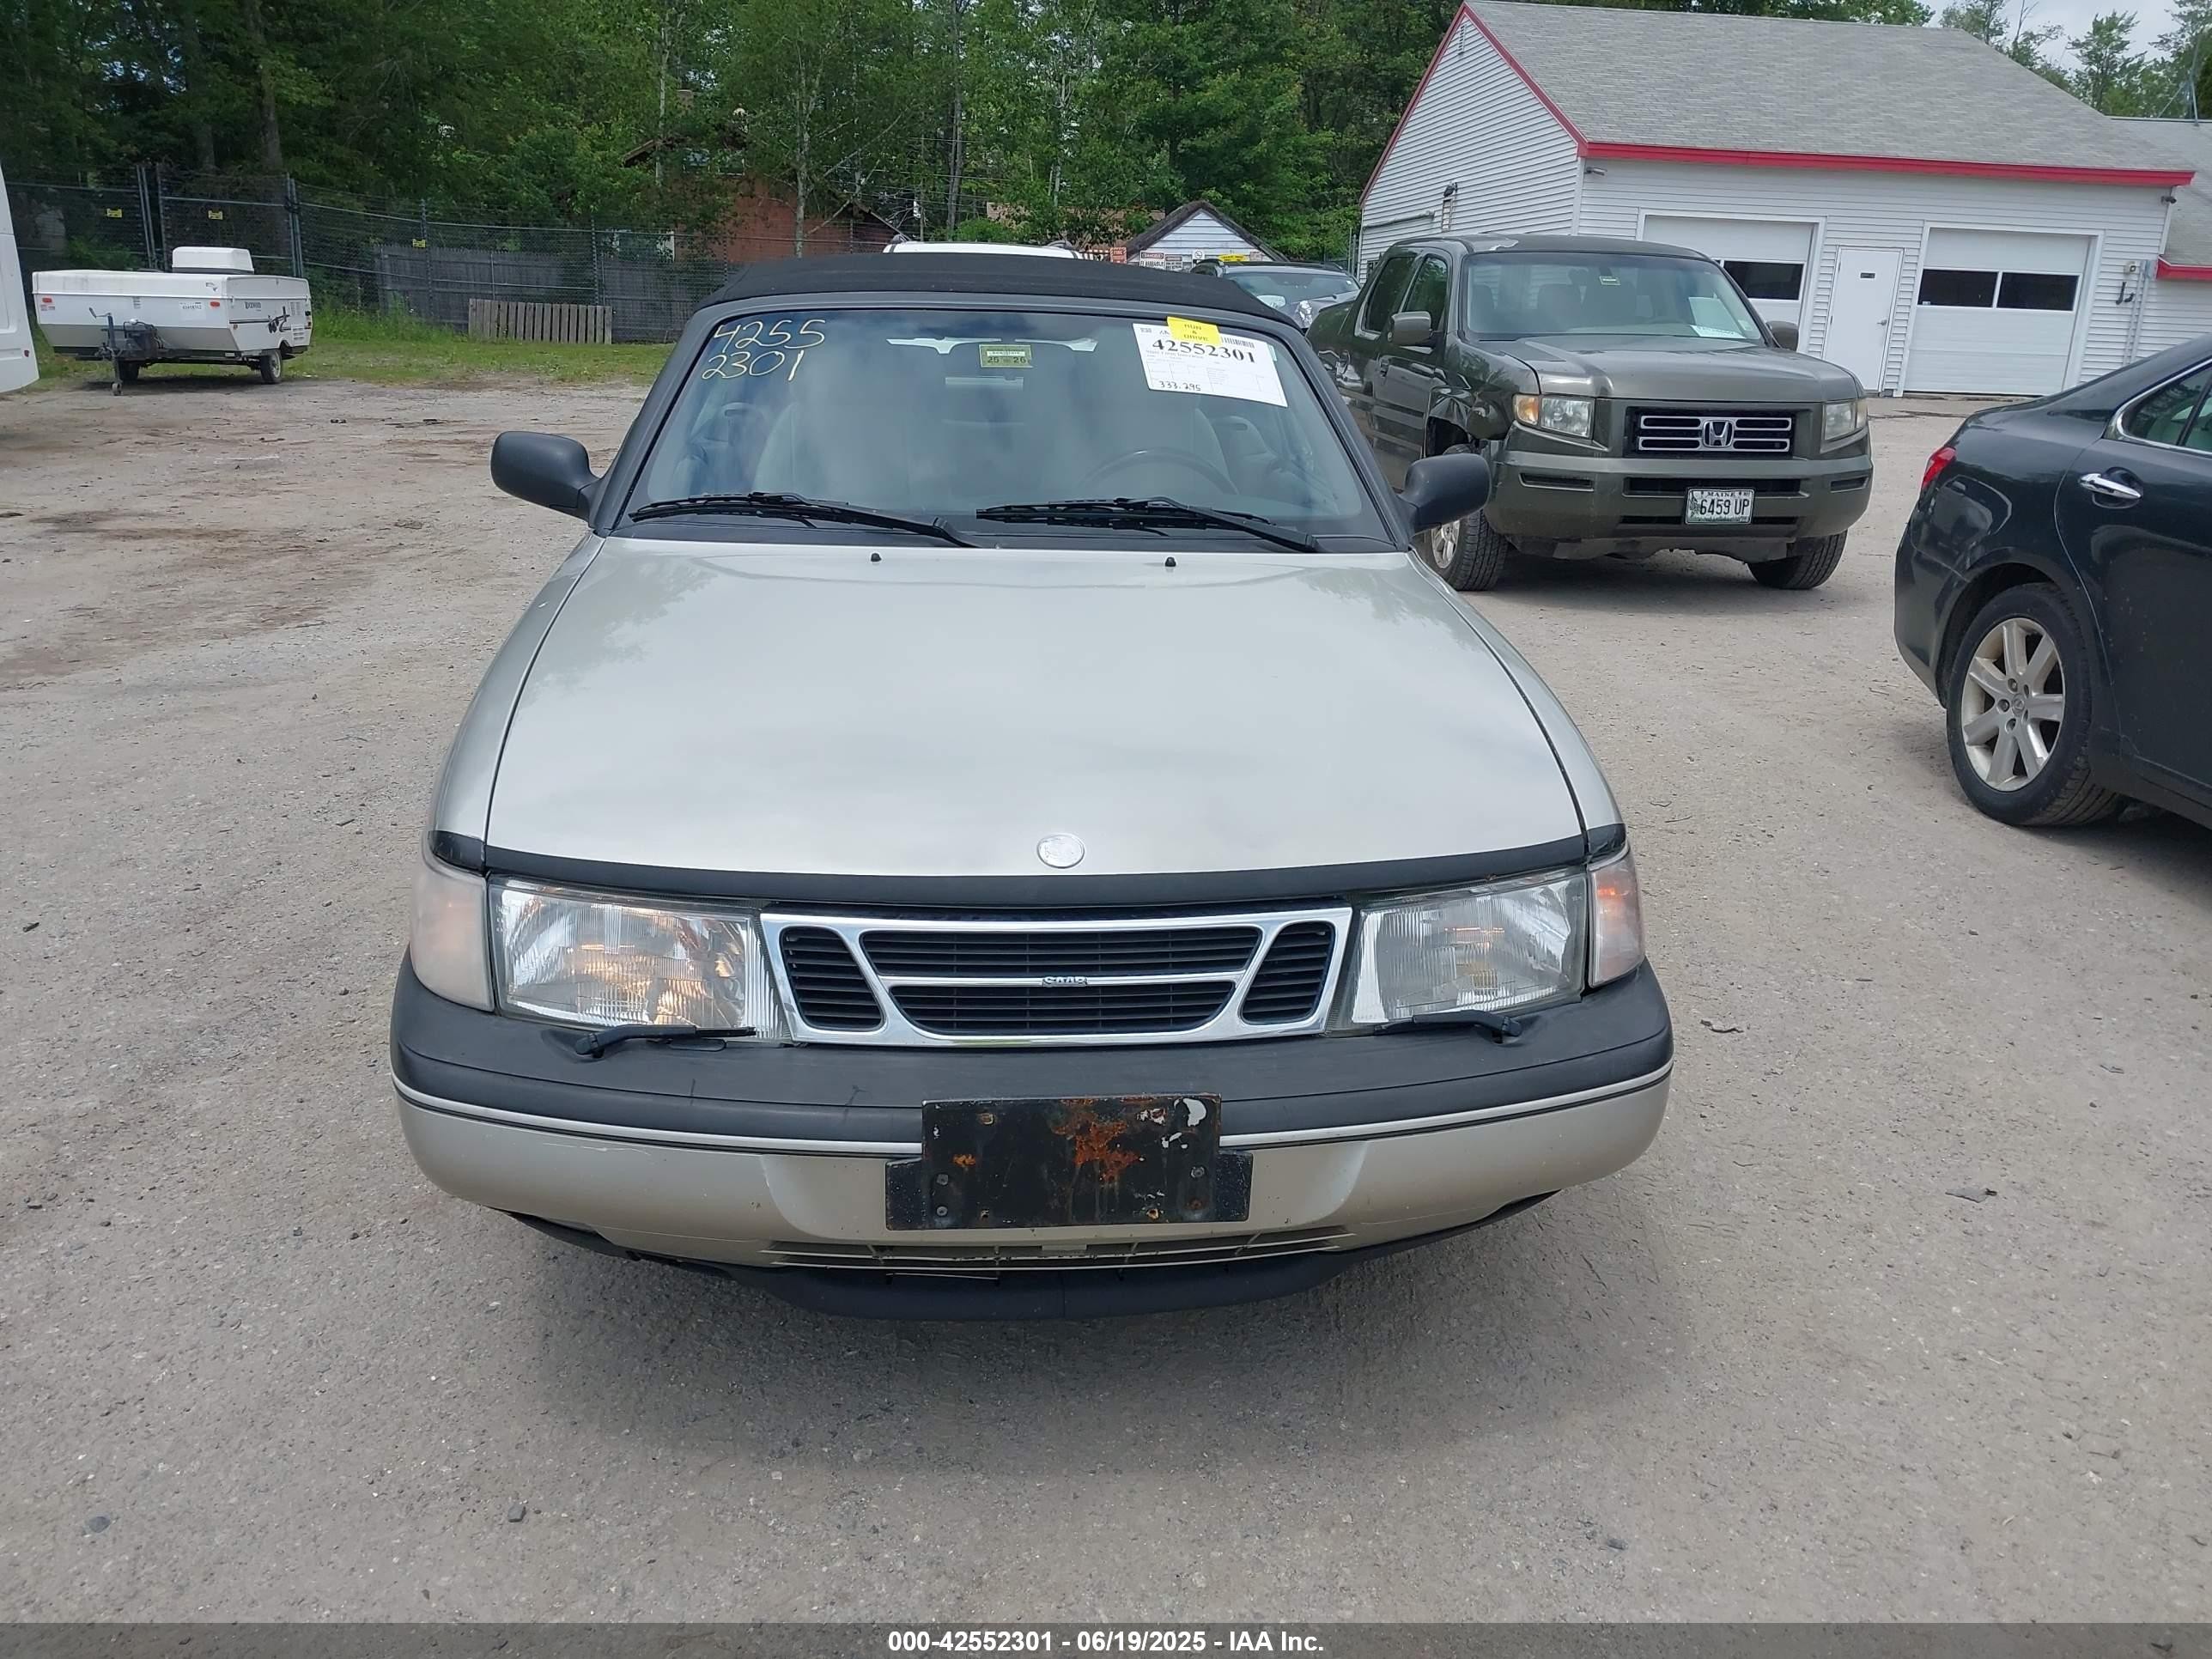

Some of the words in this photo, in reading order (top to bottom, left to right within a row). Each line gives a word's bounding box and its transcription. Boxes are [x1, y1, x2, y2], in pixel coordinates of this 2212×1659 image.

[714, 319, 826, 353] 4255
[1152, 338, 1255, 363] 42552301
[702, 349, 805, 381] 2301
[1700, 499, 1731, 515] 6459
[1735, 499, 1749, 515] UP
[1042, 975, 1087, 988] SAAB
